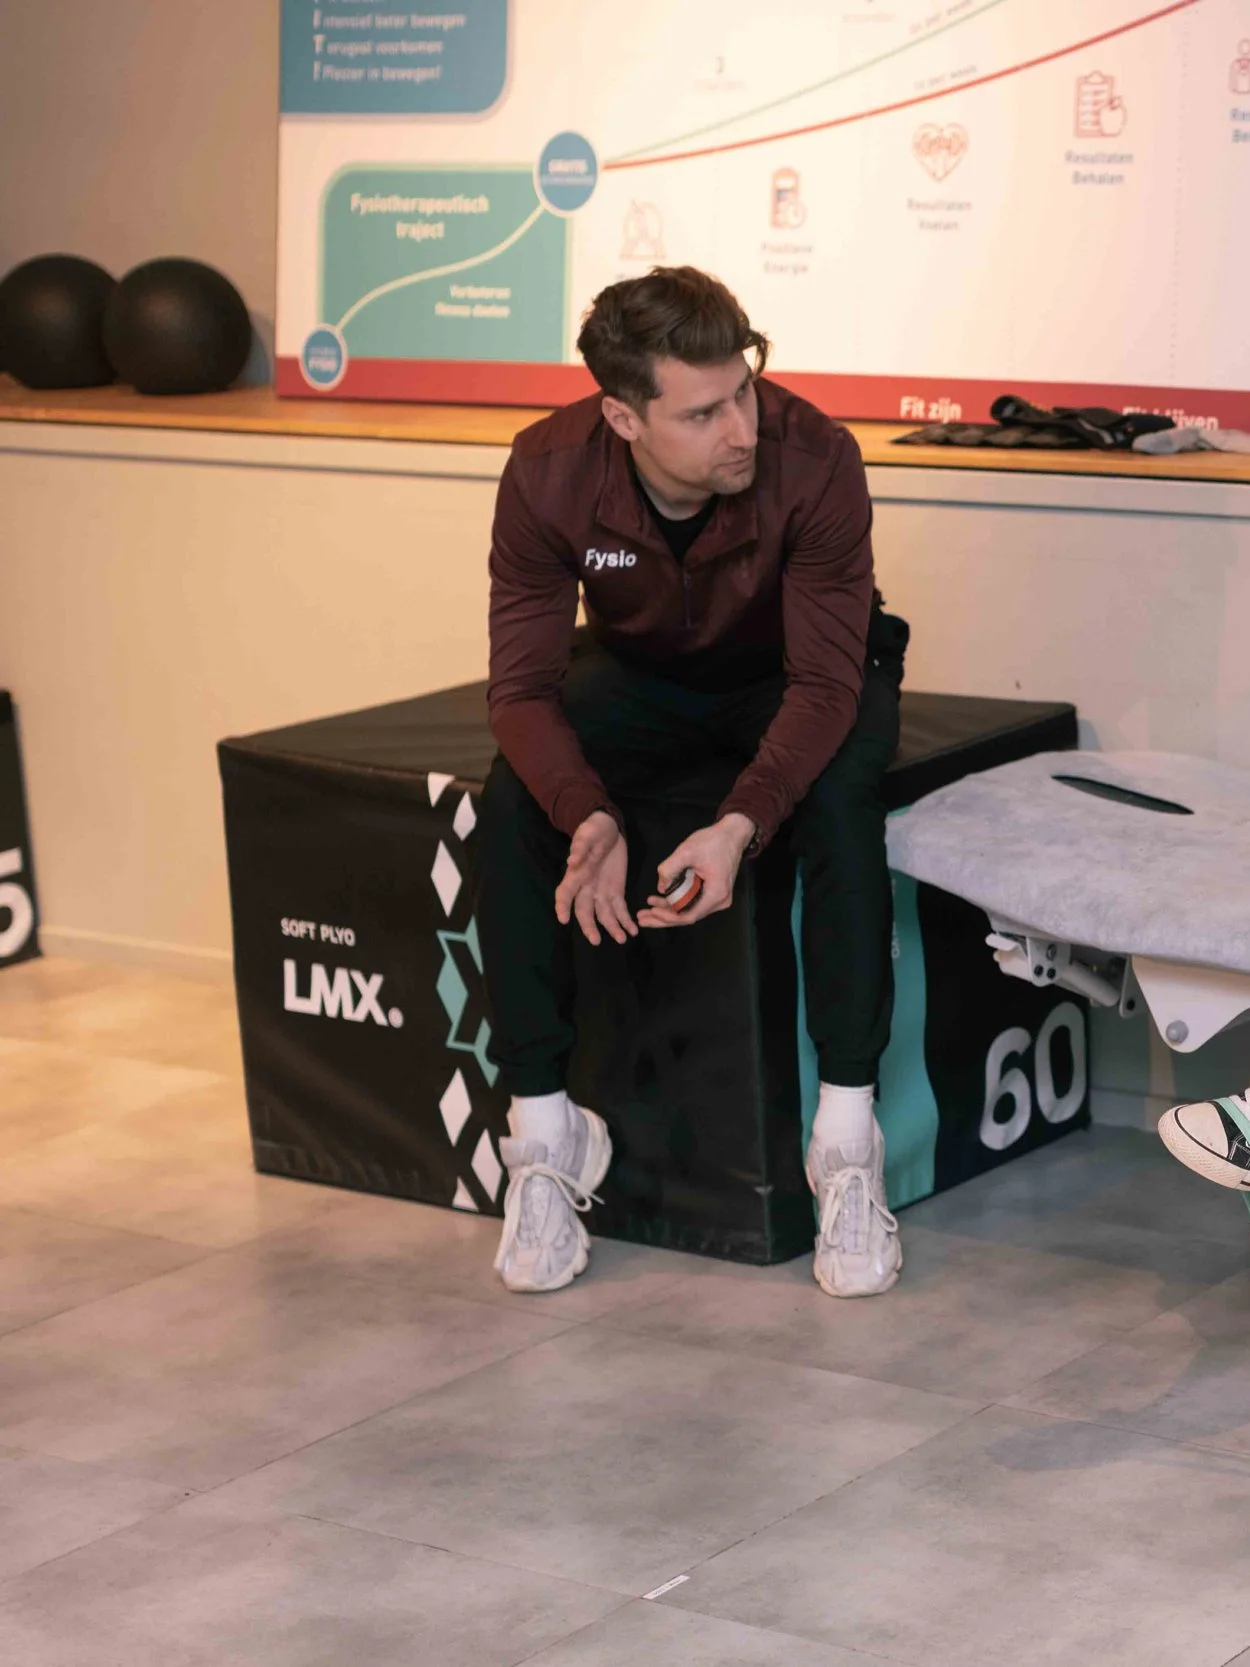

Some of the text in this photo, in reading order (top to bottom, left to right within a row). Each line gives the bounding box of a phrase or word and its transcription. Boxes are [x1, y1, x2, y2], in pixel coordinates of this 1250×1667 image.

[1065, 151, 1133, 164] Resultaten
[351, 193, 490, 217] Fysiotherapeutisch
[396, 220, 445, 242] traject
[900, 396, 962, 424] Fit zijn
[584, 548, 637, 570] Fysio
[281, 917, 356, 947] SOFT PLYO
[284, 958, 404, 1029] LMX.
[980, 1001, 1087, 1151] 60
